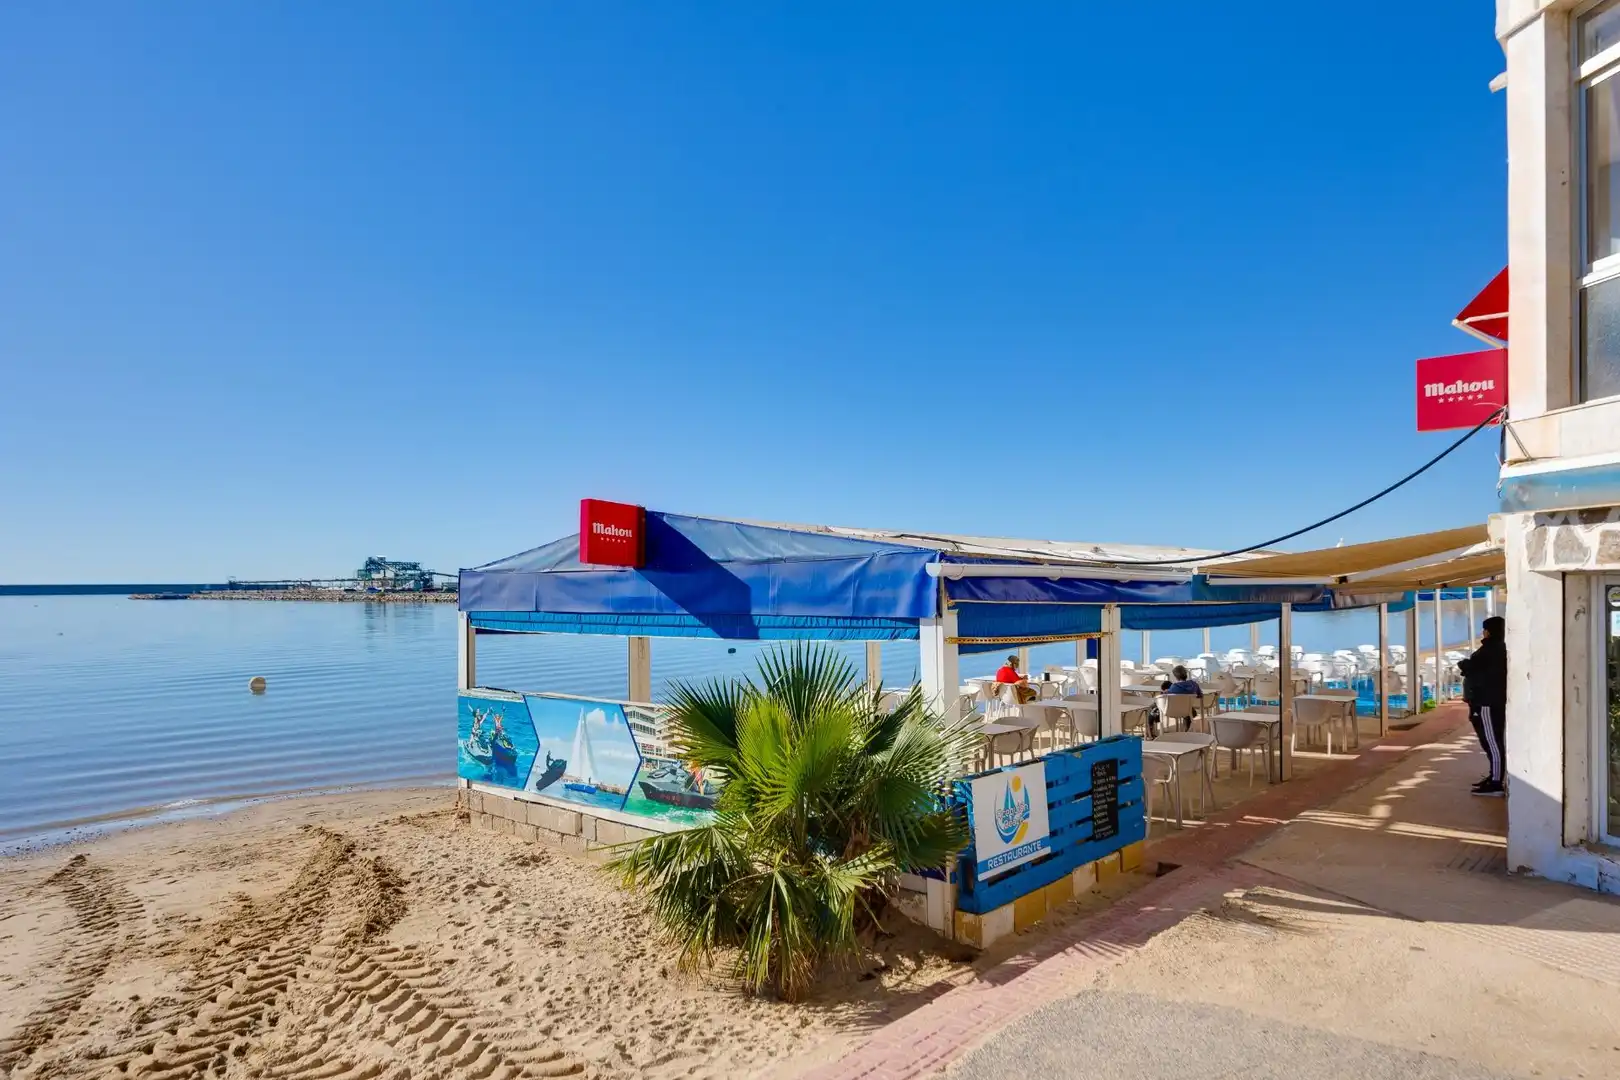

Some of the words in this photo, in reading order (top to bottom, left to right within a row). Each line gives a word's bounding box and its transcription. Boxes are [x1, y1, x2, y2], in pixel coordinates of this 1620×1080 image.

[1424, 380, 1495, 397] Mahou
[592, 522, 632, 537] Mahou
[987, 840, 1042, 870] RESTAURANTE
